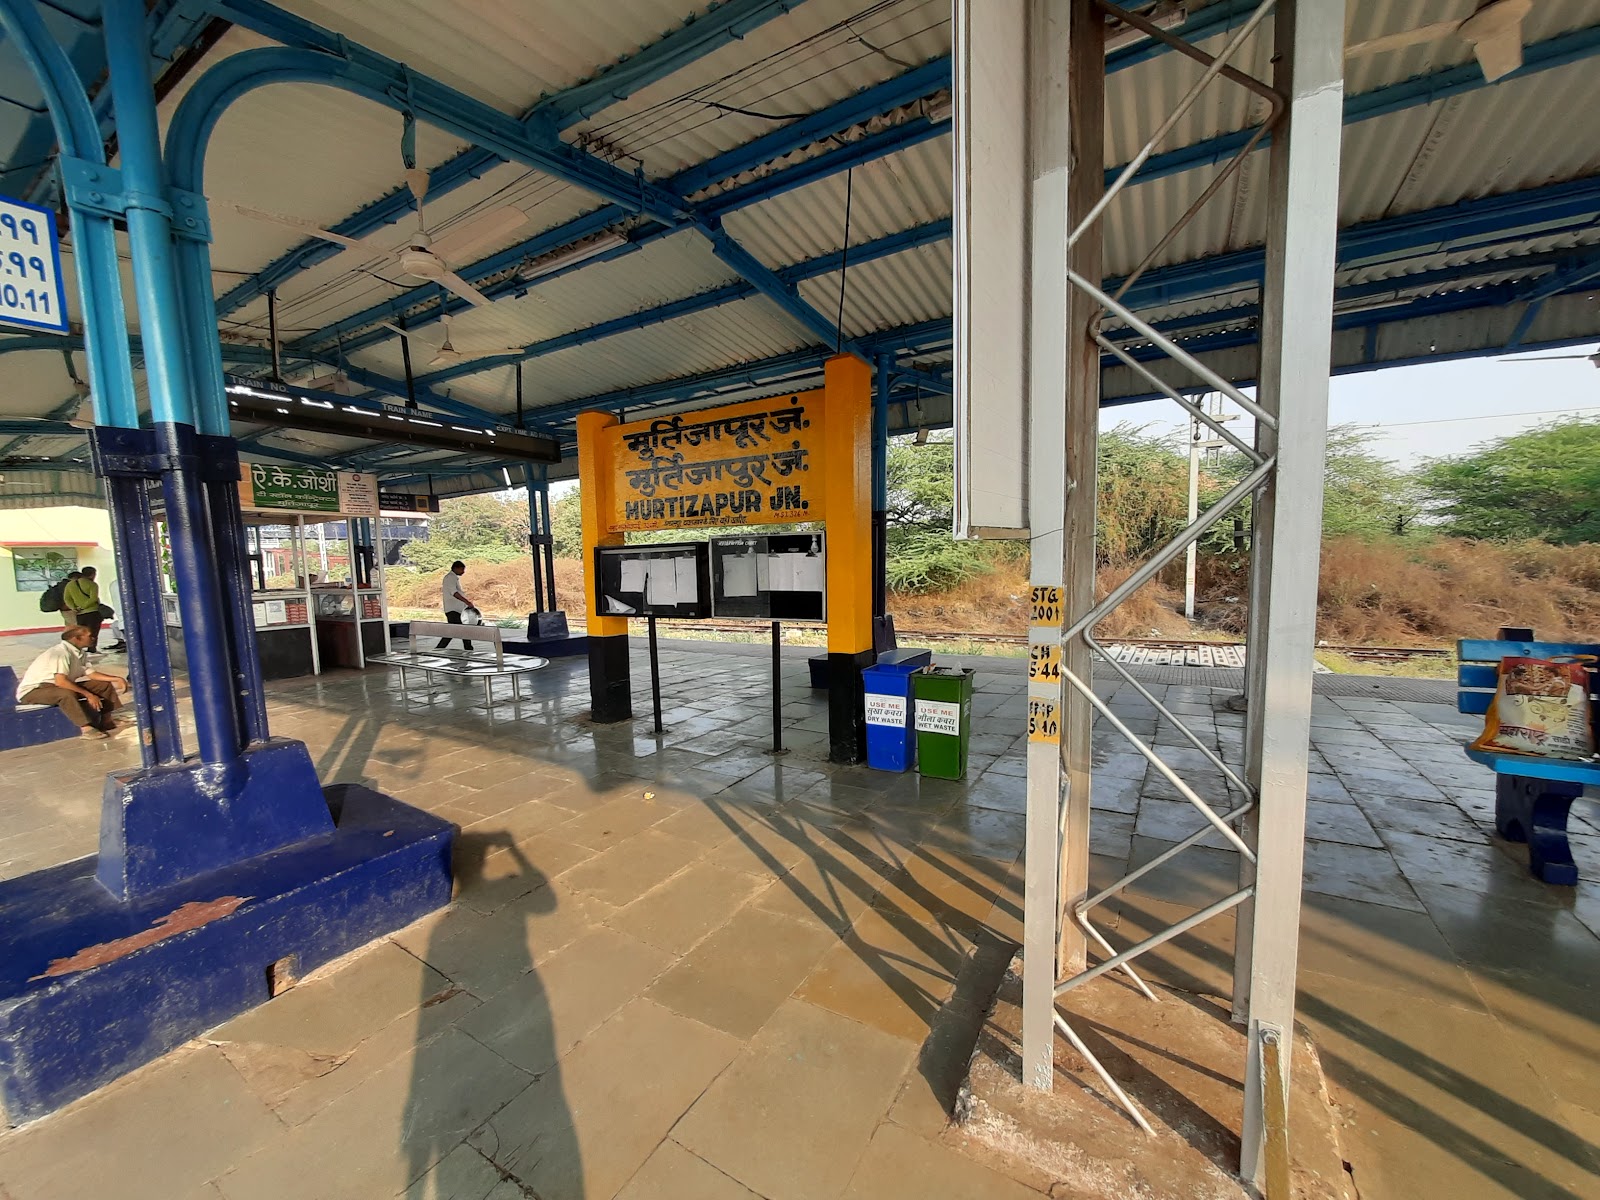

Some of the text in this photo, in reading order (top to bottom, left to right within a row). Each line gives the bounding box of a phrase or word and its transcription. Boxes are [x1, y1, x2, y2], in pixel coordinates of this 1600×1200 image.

[231, 375, 264, 389] TRAIN
[382, 403, 433, 419] TRAIN NAME
[769, 396, 811, 434] जं.
[771, 440, 809, 476] जं.
[625, 485, 809, 521] MURTIZAPUR JN.
[1030, 587, 1059, 604] STG
[881, 716, 902, 724] WASTE
